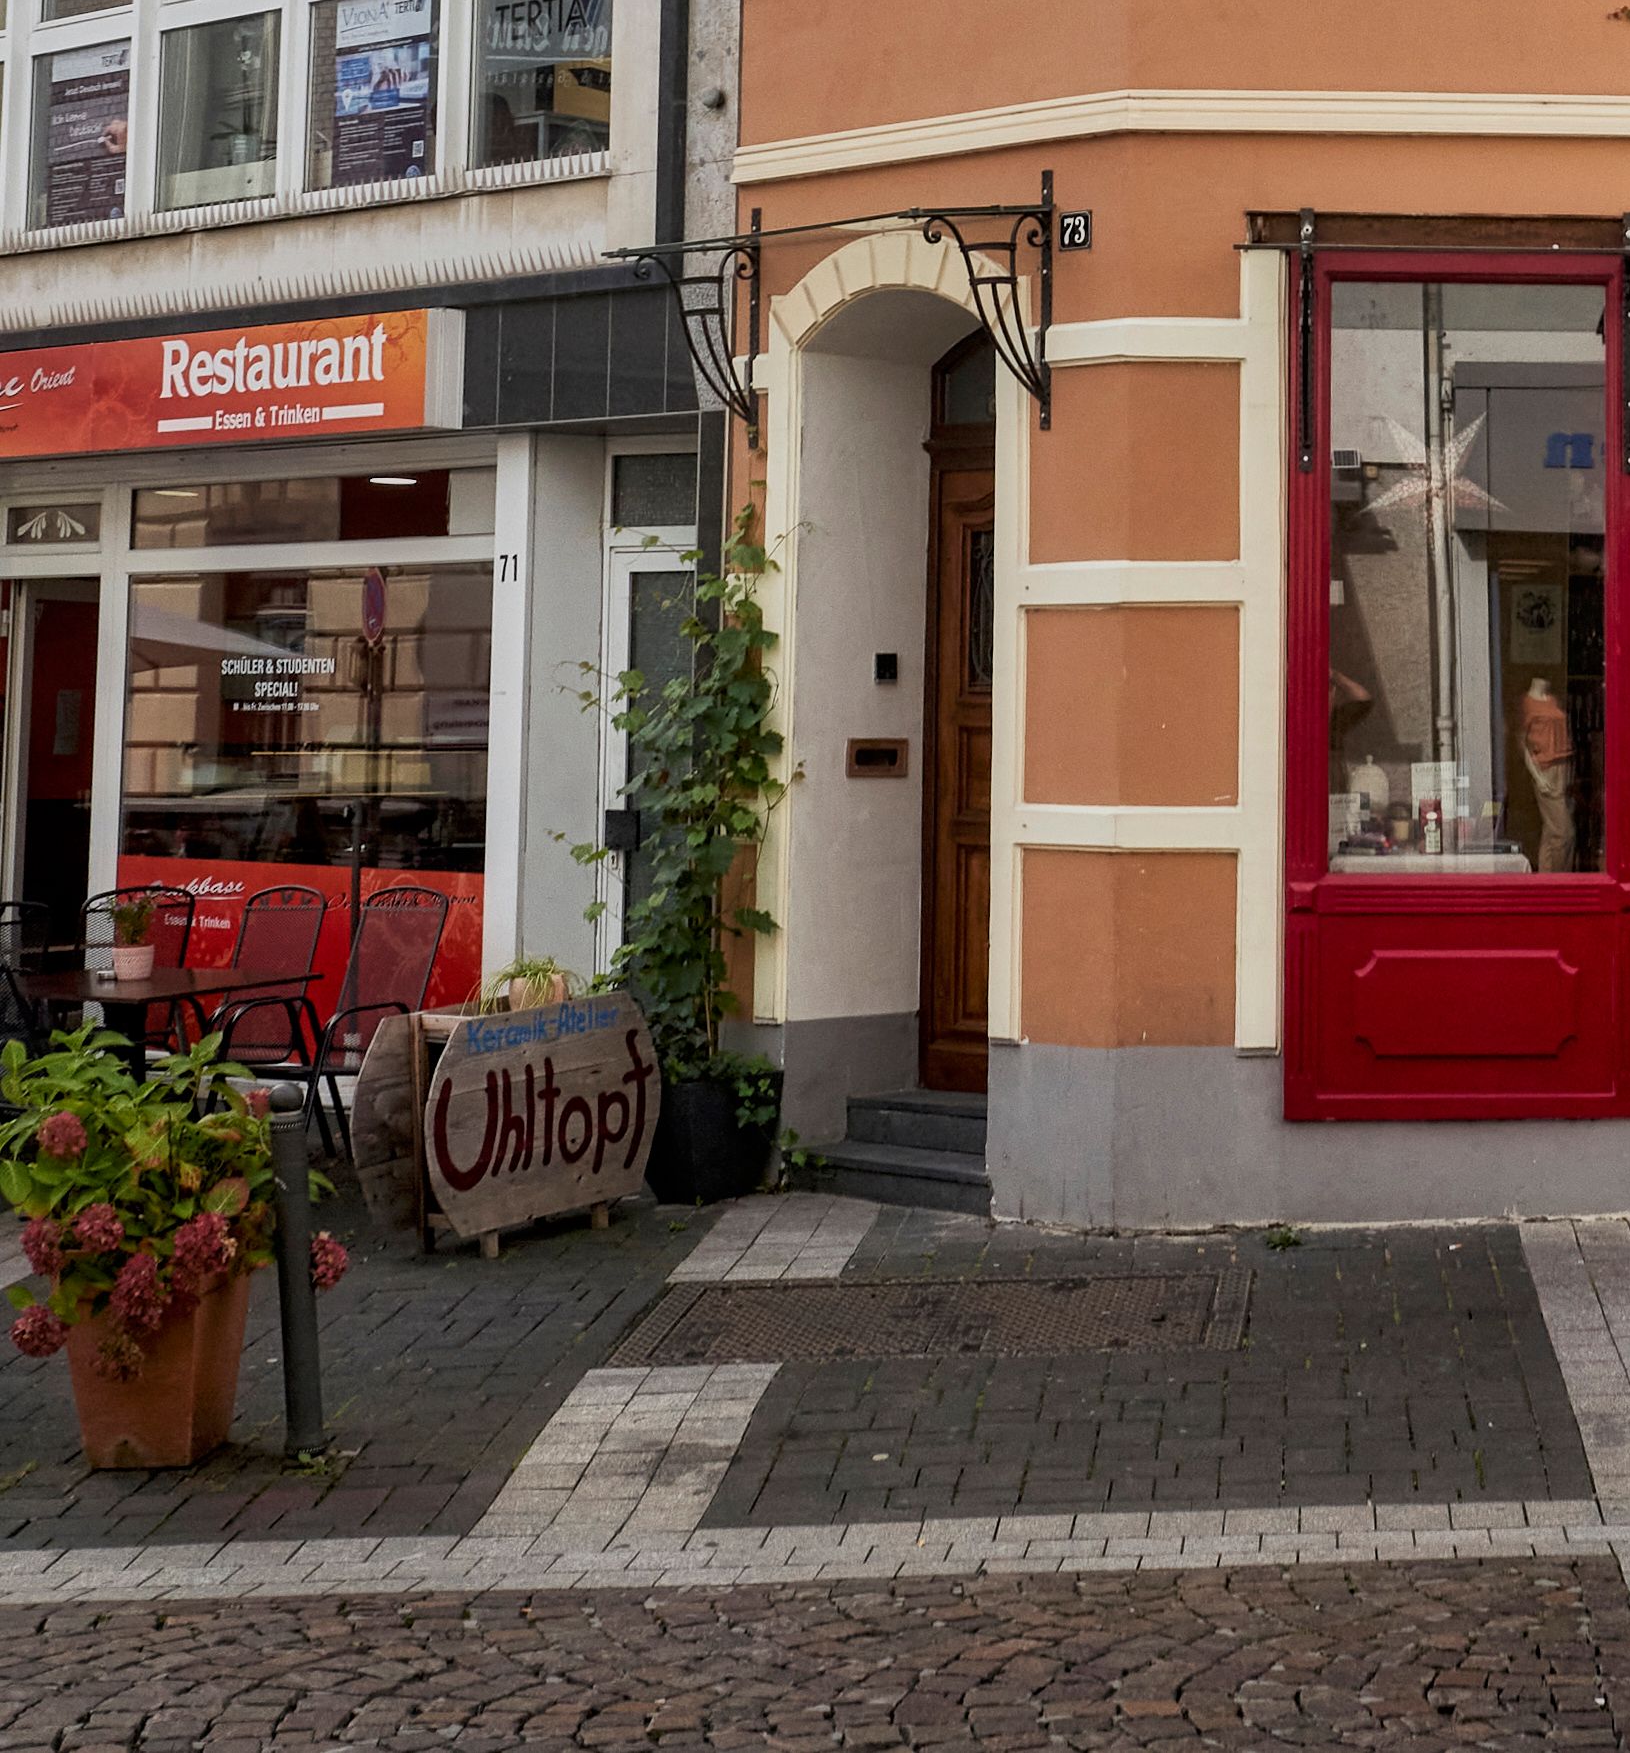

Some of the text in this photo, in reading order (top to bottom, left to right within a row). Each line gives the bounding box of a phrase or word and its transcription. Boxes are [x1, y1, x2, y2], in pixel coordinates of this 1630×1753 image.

[1063, 215, 1086, 246] 73
[159, 322, 388, 399] Restaurant
[30, 365, 76, 393] Orient
[214, 403, 321, 431] Essen & Trinken
[500, 554, 518, 582] 71
[221, 656, 335, 675] SCHÜLER & STUDENTEN
[254, 681, 299, 697] SPECIAL!
[199, 915, 231, 930] Trinken
[466, 1002, 619, 1055] Keramik-Atelier
[433, 1029, 654, 1192] Uhltopf
